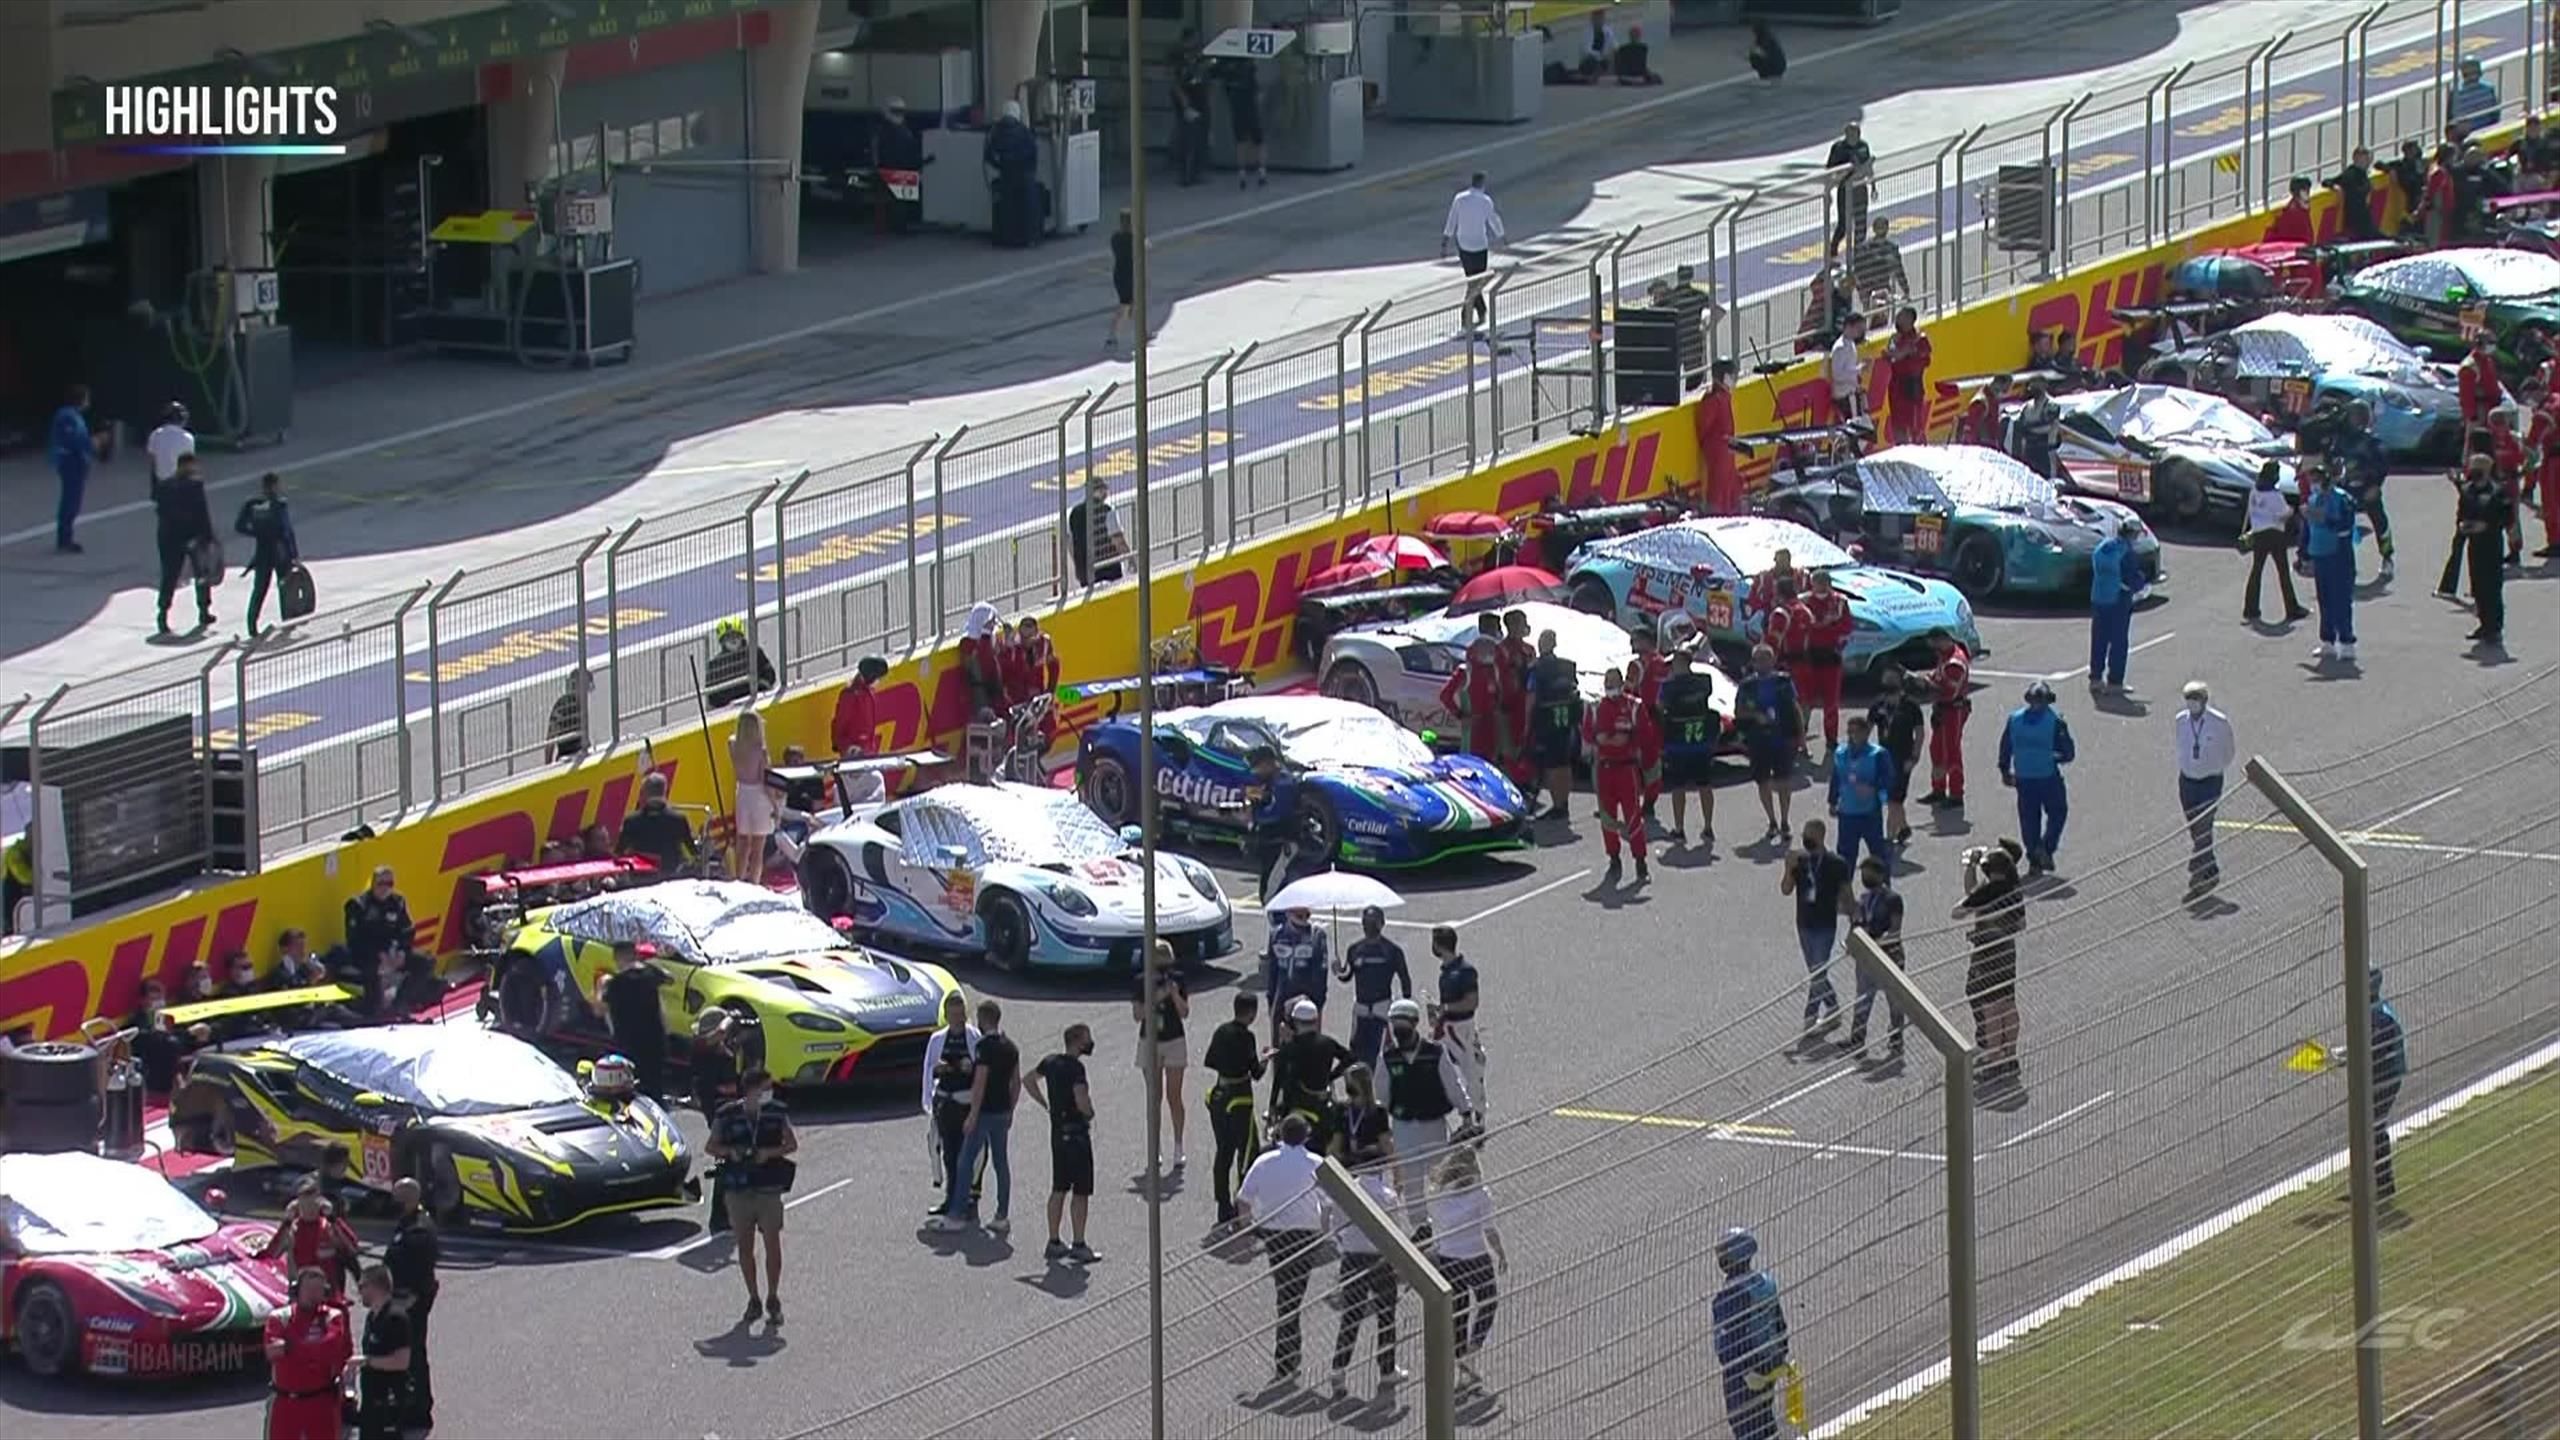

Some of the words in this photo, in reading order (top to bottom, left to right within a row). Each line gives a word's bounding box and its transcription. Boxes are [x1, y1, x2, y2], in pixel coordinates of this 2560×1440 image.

[1251, 36, 1269, 53] 21
[566, 206, 595, 225] 56
[1188, 530, 1370, 673] DH
[1708, 602, 1731, 630] 33
[1157, 766, 1242, 807] Cetilar
[364, 1147, 391, 1178] 60
